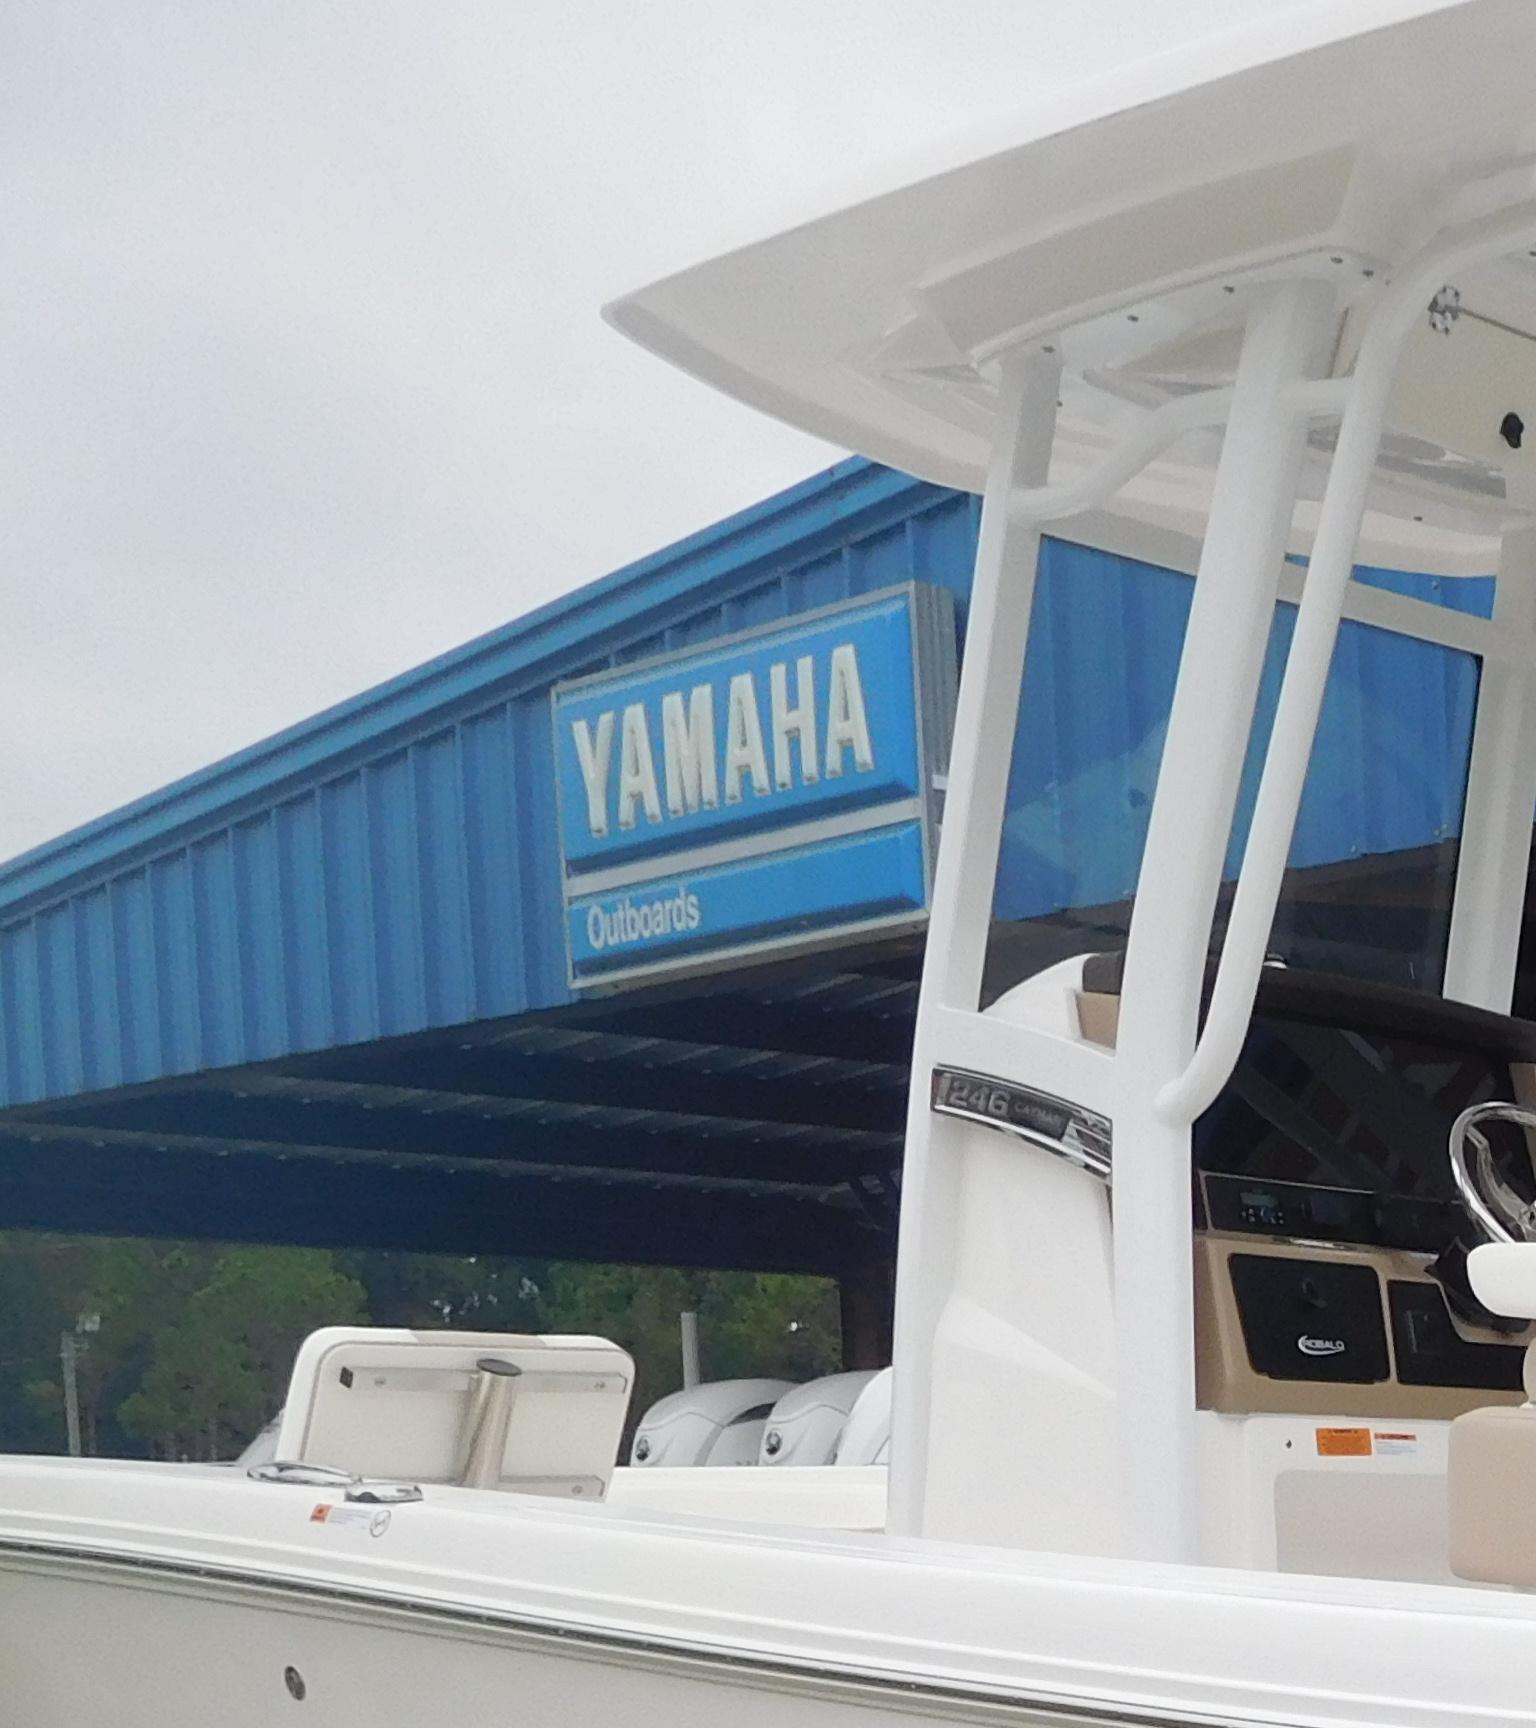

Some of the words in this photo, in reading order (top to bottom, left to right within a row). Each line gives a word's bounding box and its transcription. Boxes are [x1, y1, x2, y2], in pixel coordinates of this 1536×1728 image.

[572, 643, 875, 839] YAMAHA
[587, 887, 701, 949] Outboards
[950, 1081, 1009, 1118] 246
